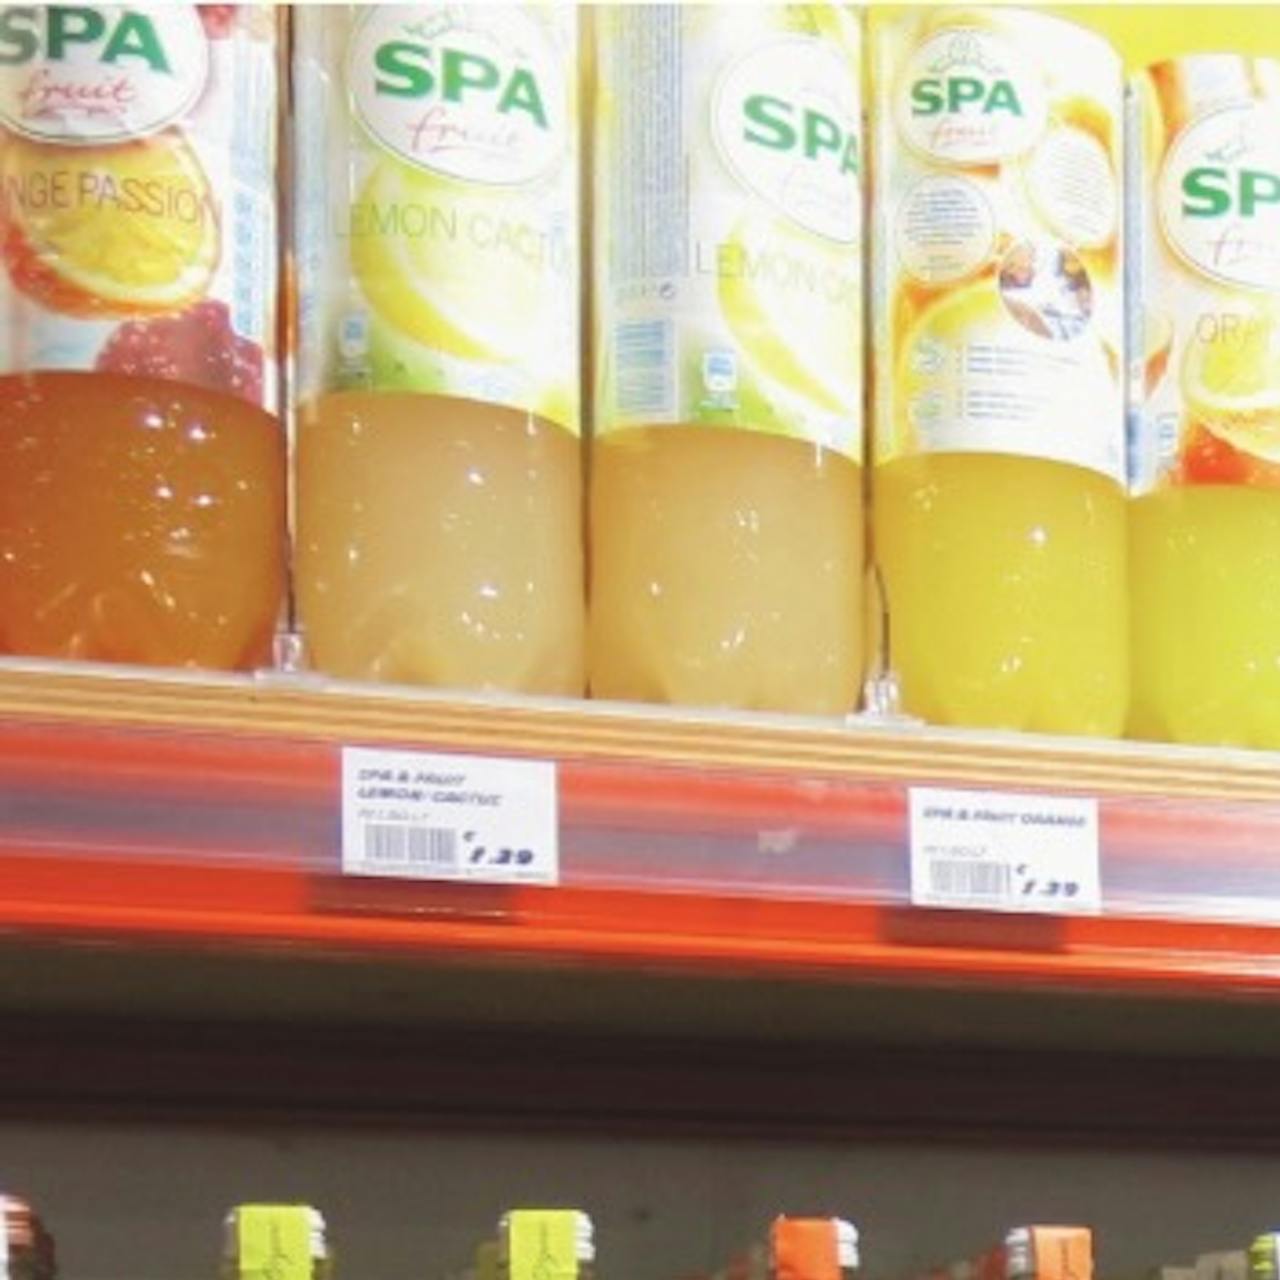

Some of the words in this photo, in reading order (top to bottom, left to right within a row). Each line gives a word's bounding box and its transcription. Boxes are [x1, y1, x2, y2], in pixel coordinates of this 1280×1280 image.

[373, 40, 549, 131] SPA
[911, 77, 1025, 118] SPA
[77, 170, 203, 224] PASSIO
